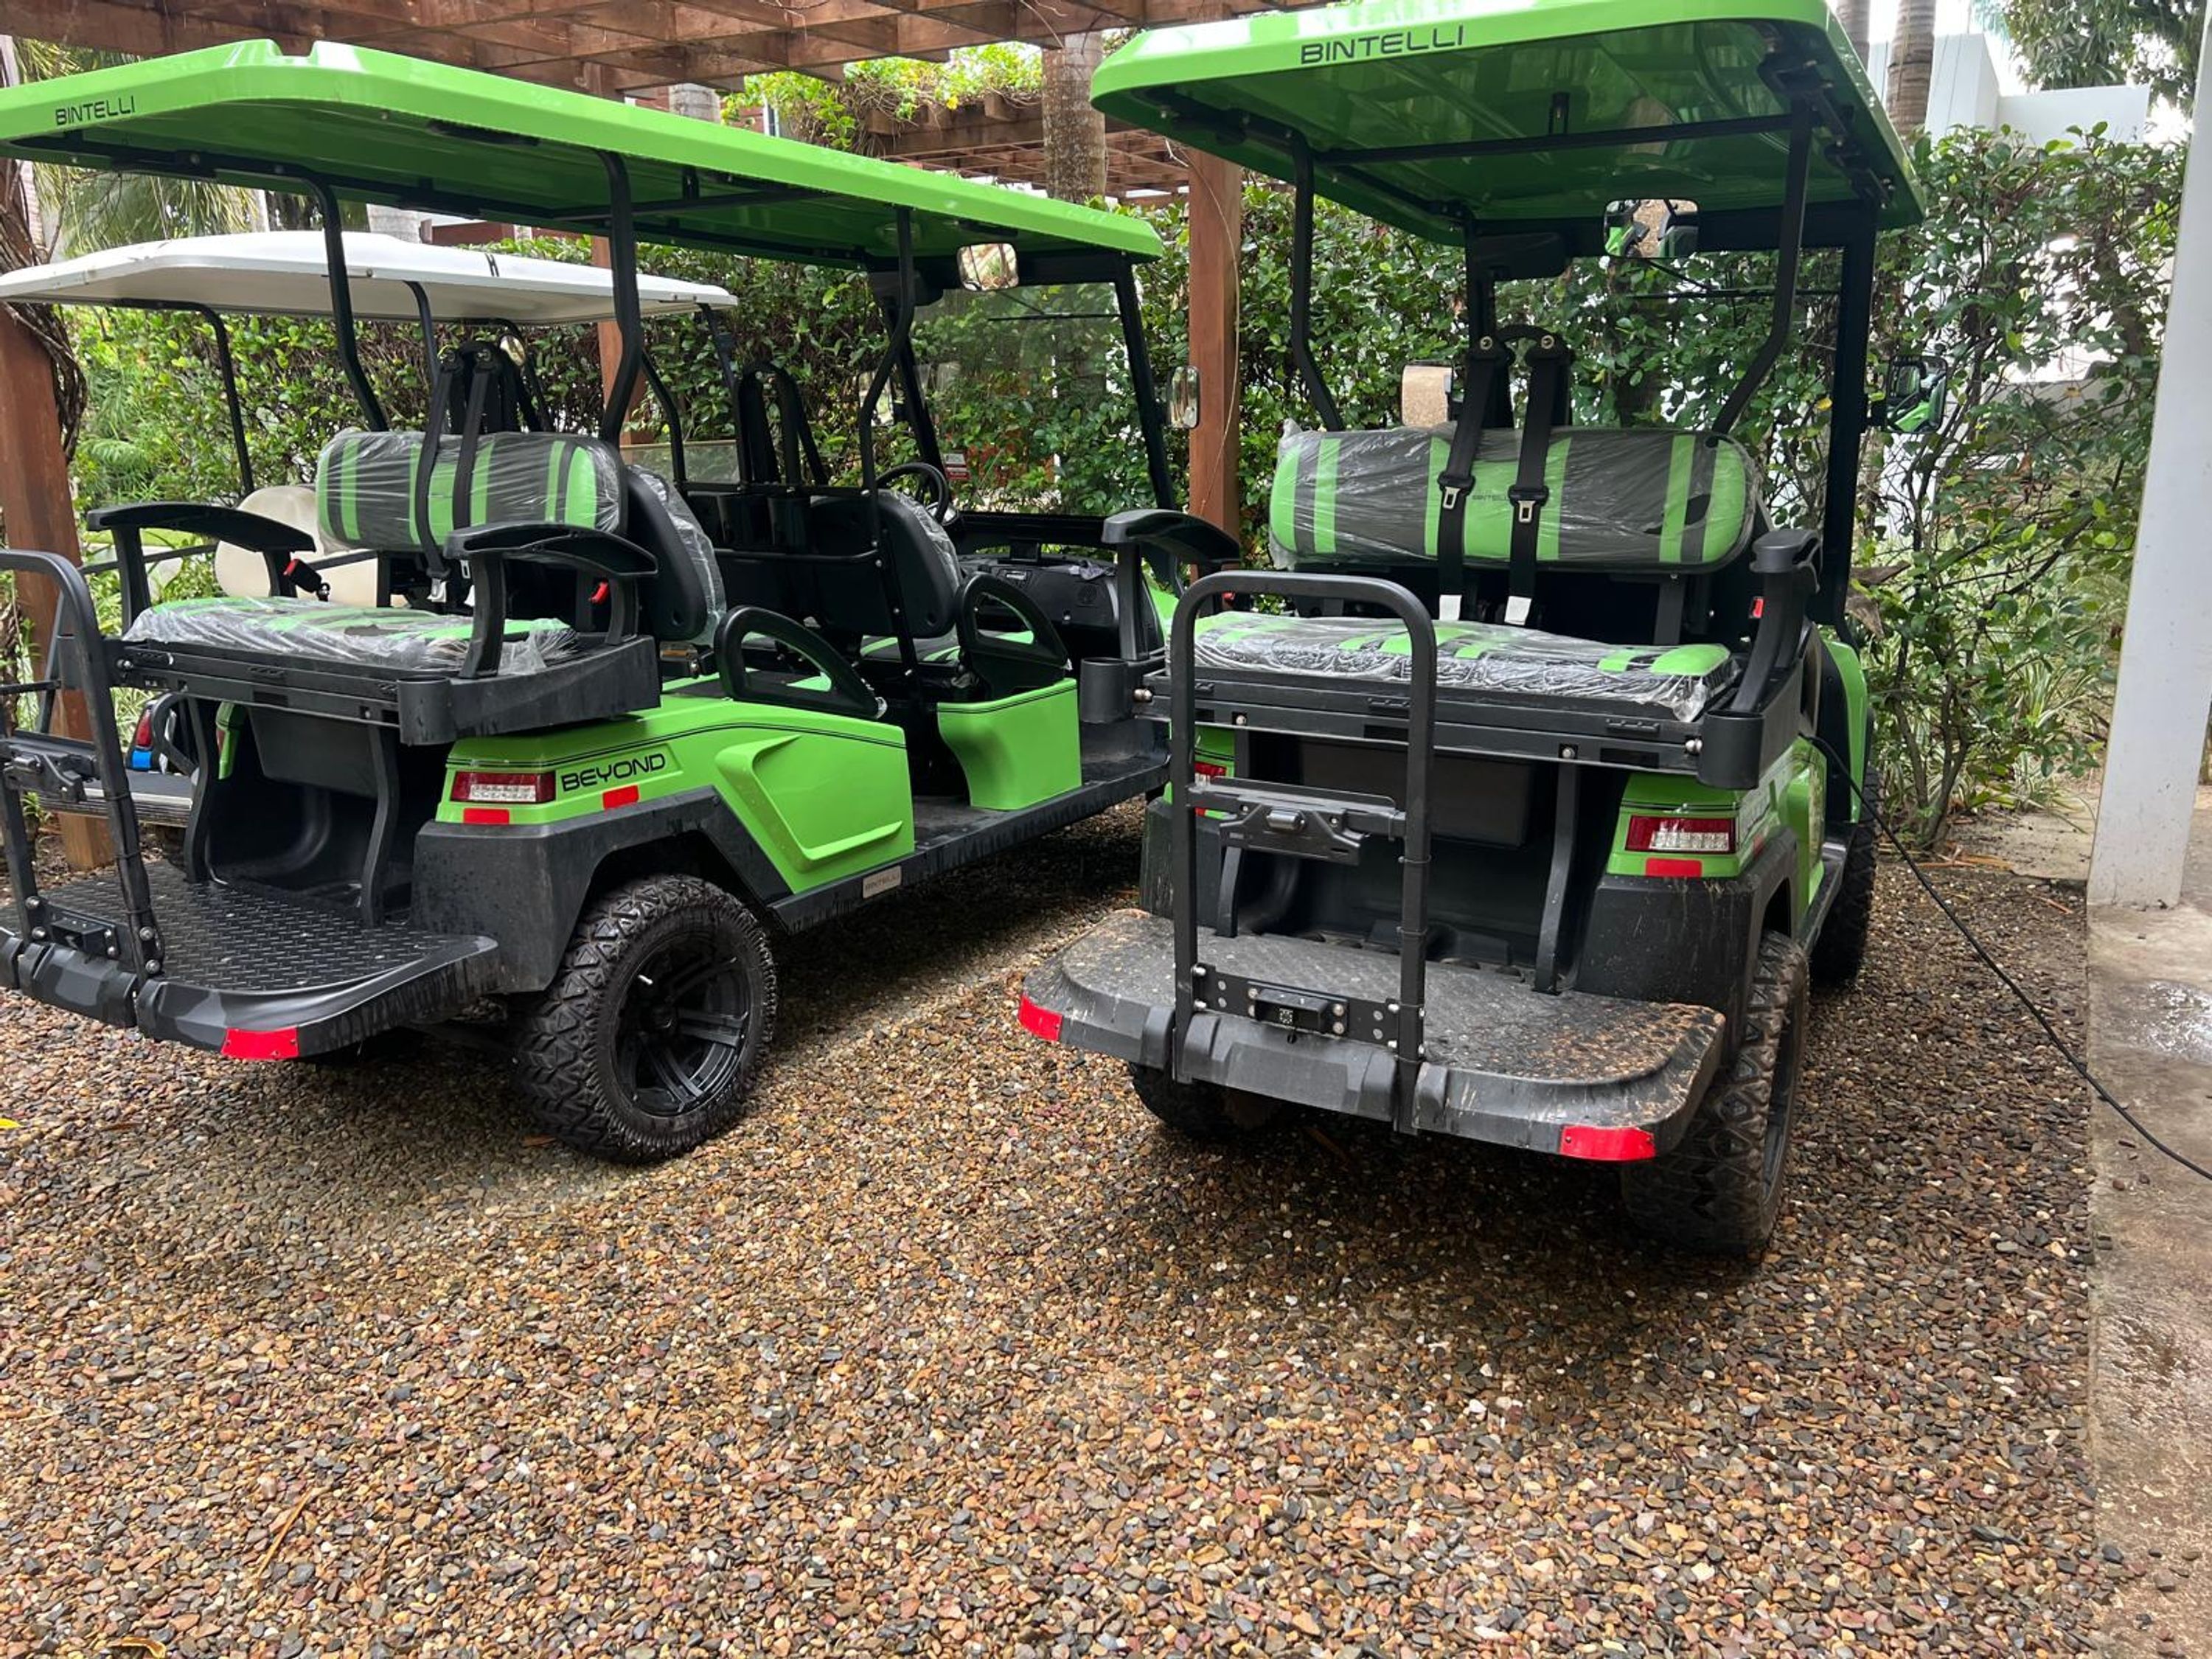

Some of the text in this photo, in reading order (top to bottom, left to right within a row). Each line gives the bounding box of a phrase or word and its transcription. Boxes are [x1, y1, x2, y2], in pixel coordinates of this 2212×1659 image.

[1301, 24, 1464, 65] BINTELLI
[55, 95, 136, 125] BINTELLI
[560, 753, 666, 792] BEYOND
